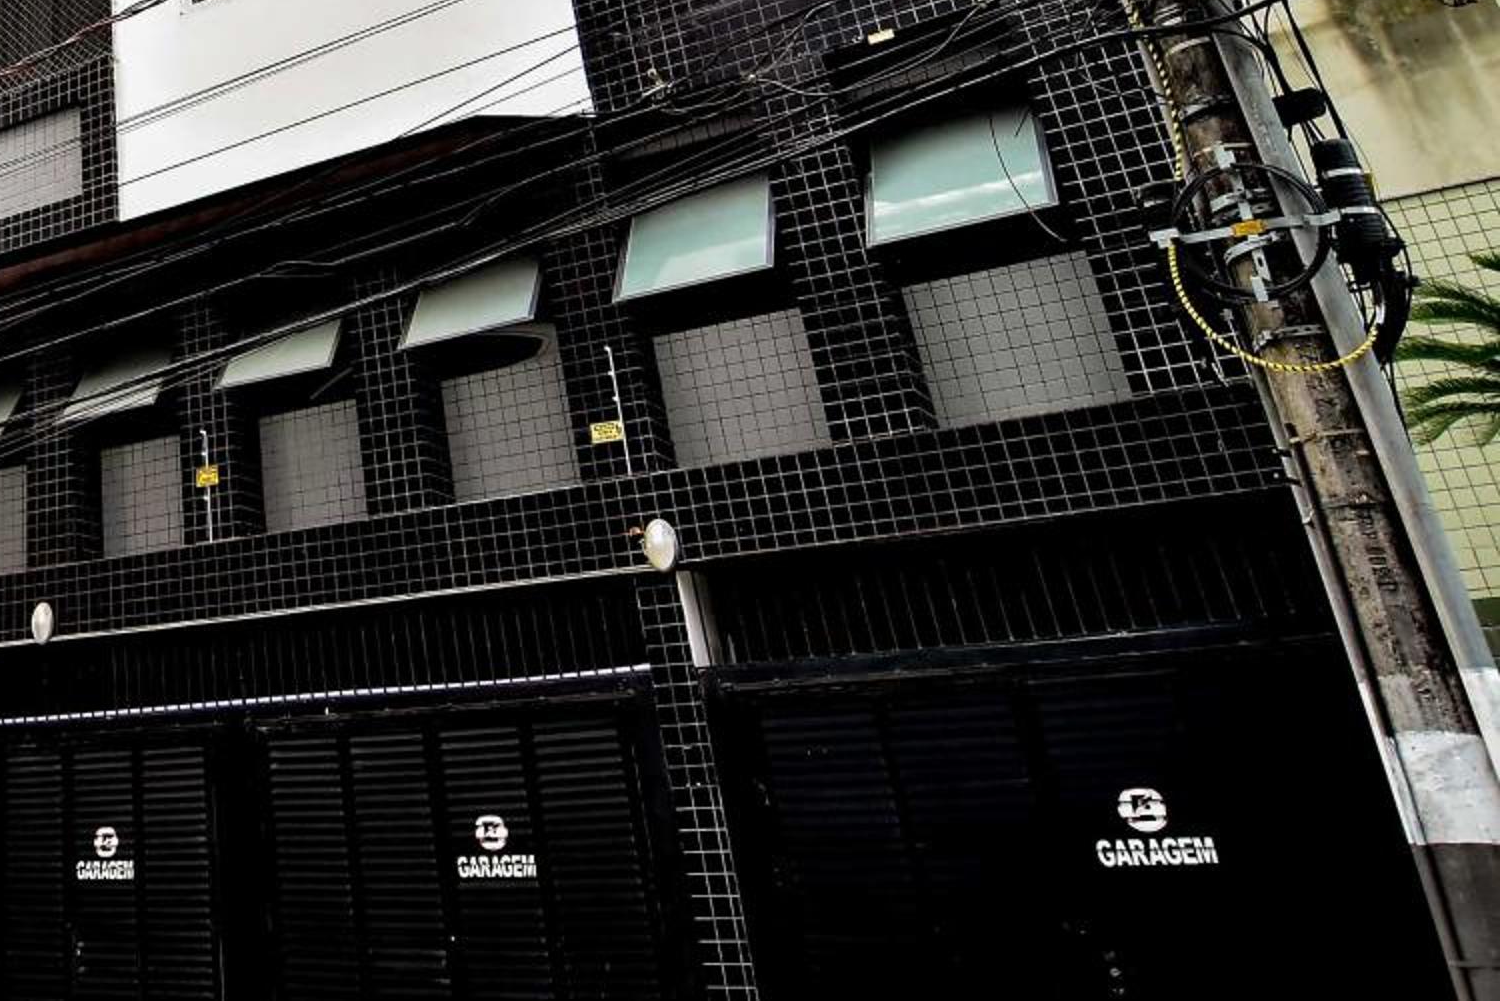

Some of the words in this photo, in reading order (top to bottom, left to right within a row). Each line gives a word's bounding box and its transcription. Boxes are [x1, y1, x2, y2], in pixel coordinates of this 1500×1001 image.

[1096, 837, 1219, 867] GARAGEM
[76, 859, 135, 879] GARAGEM
[457, 854, 537, 877] GARAGEM
